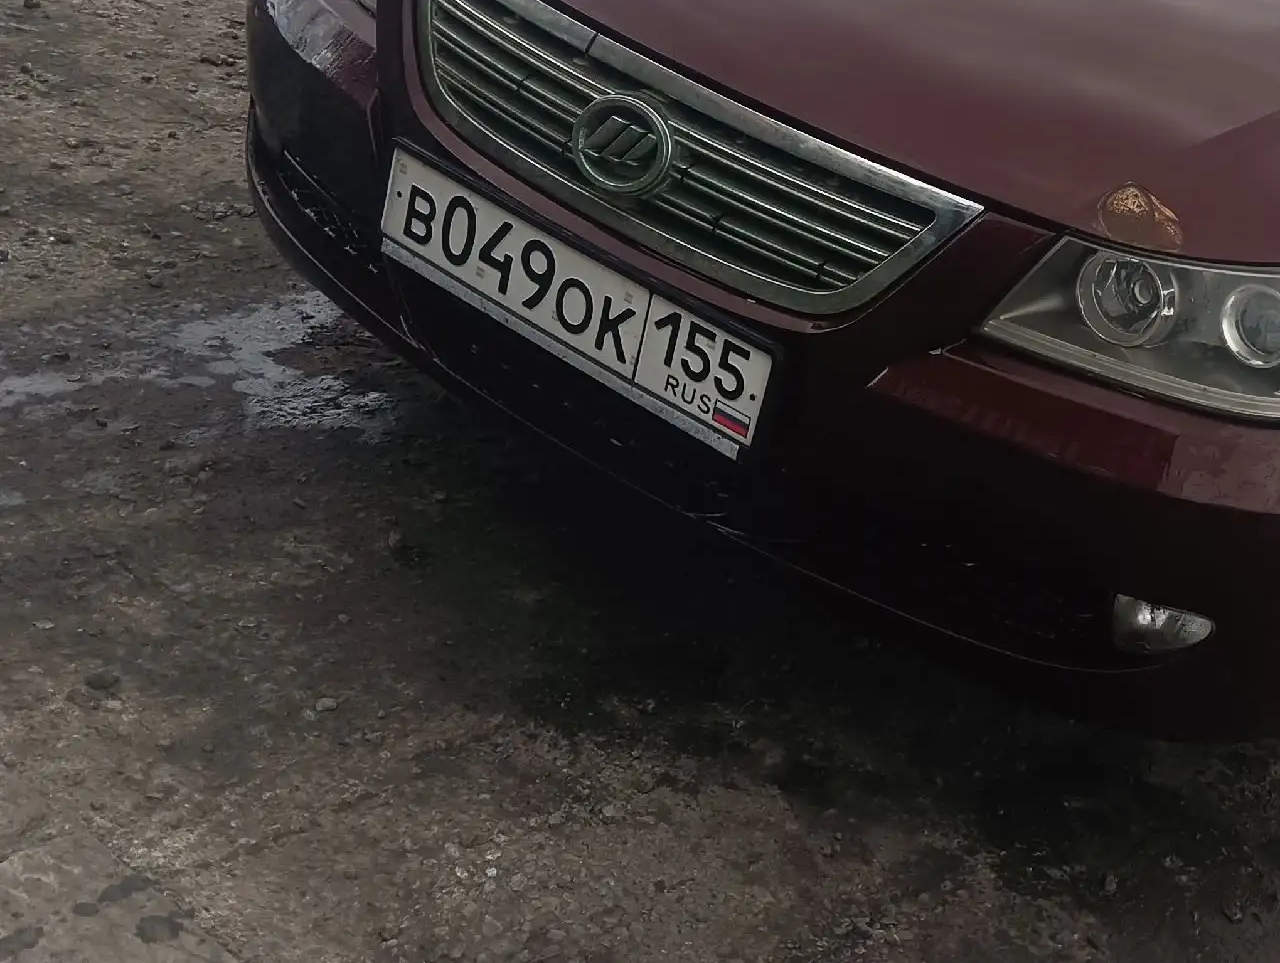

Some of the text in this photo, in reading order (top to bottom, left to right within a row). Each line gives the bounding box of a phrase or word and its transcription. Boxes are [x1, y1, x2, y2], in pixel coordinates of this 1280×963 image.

[402, 184, 752, 401] В049ОК 155
[664, 375, 712, 416] RUS
